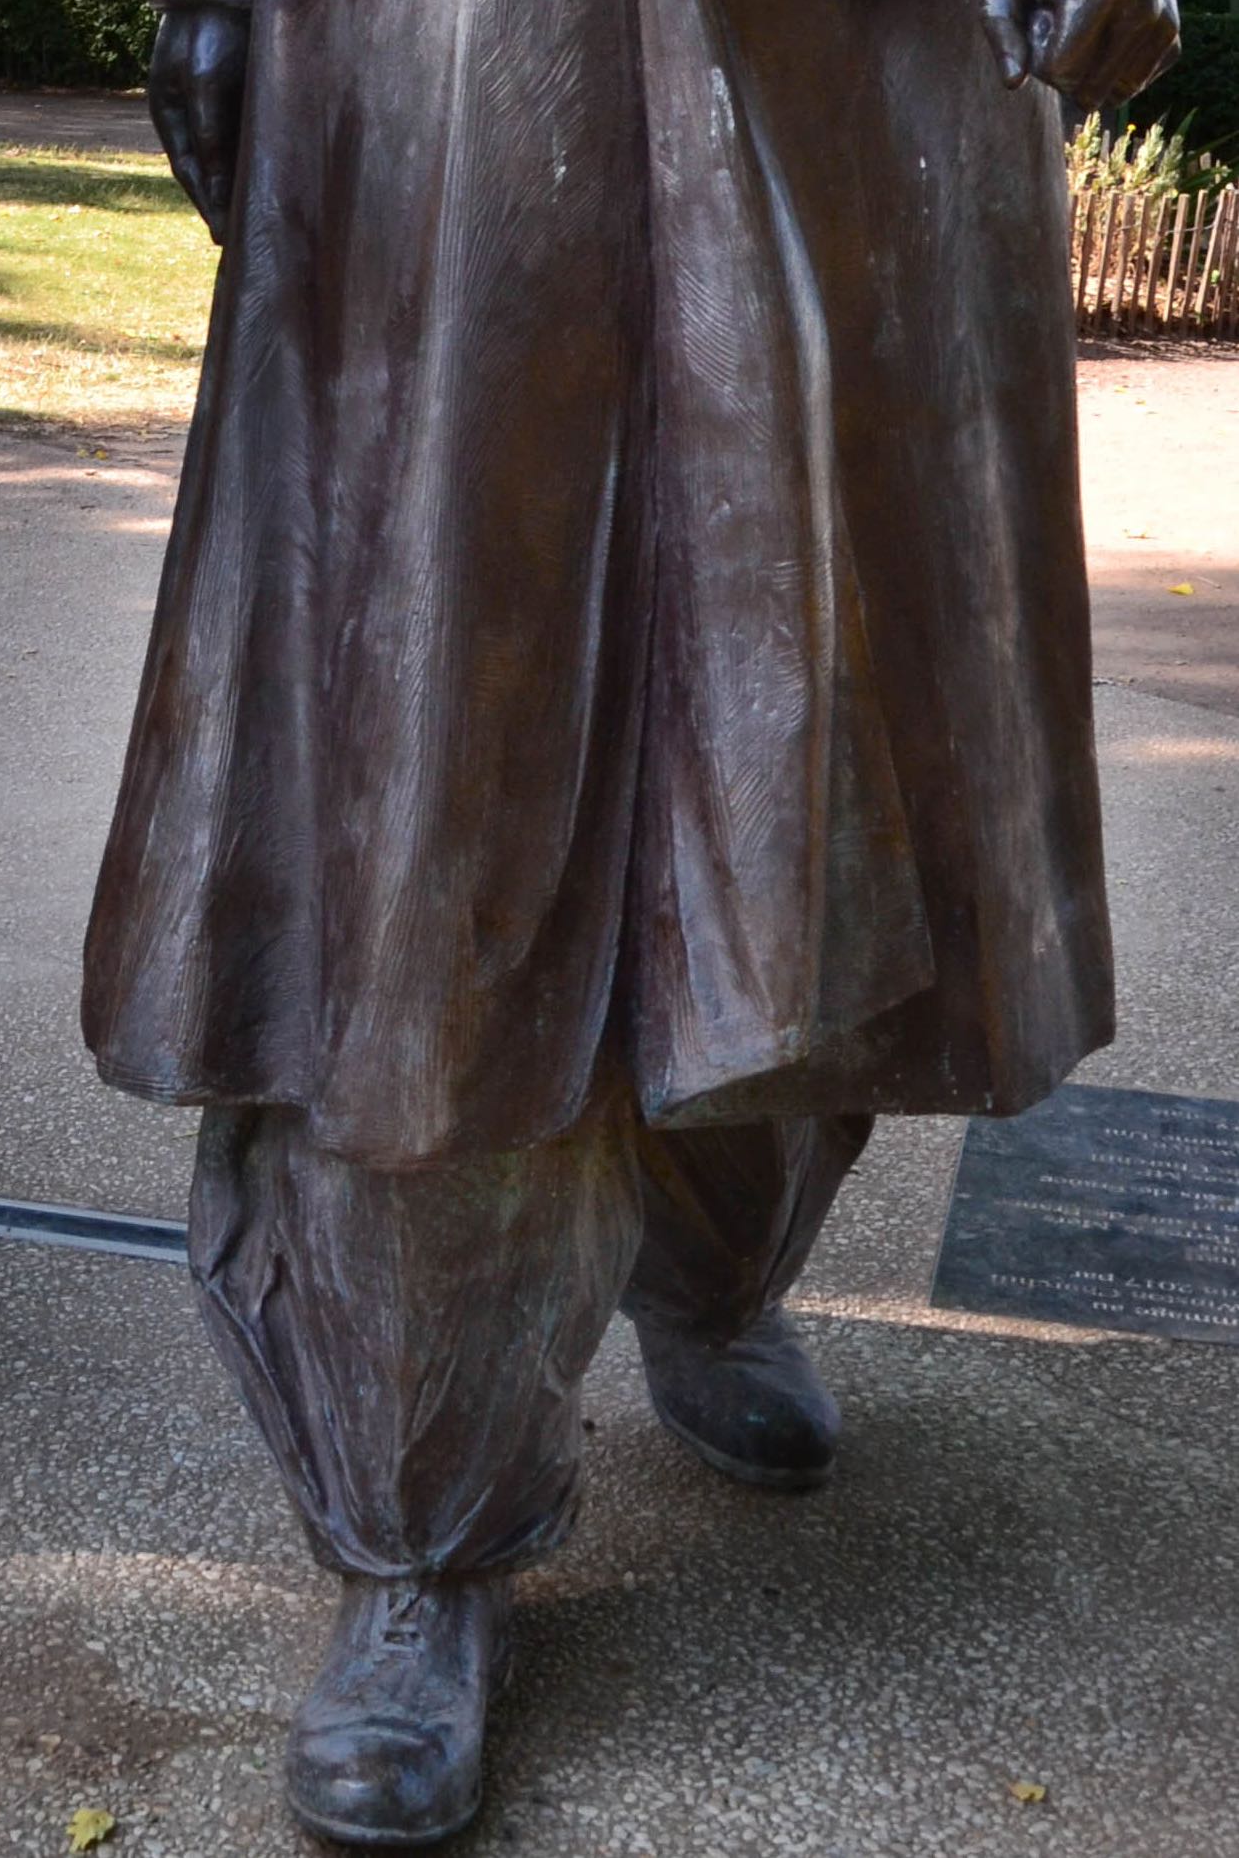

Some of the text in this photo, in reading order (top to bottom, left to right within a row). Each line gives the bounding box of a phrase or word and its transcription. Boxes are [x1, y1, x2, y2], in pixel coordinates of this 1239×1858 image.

[1070, 1269, 1113, 1281] par
[989, 1274, 1120, 1297] Churchill
[1125, 1277, 1192, 1292] 2017
[1092, 1300, 1123, 1312] au
